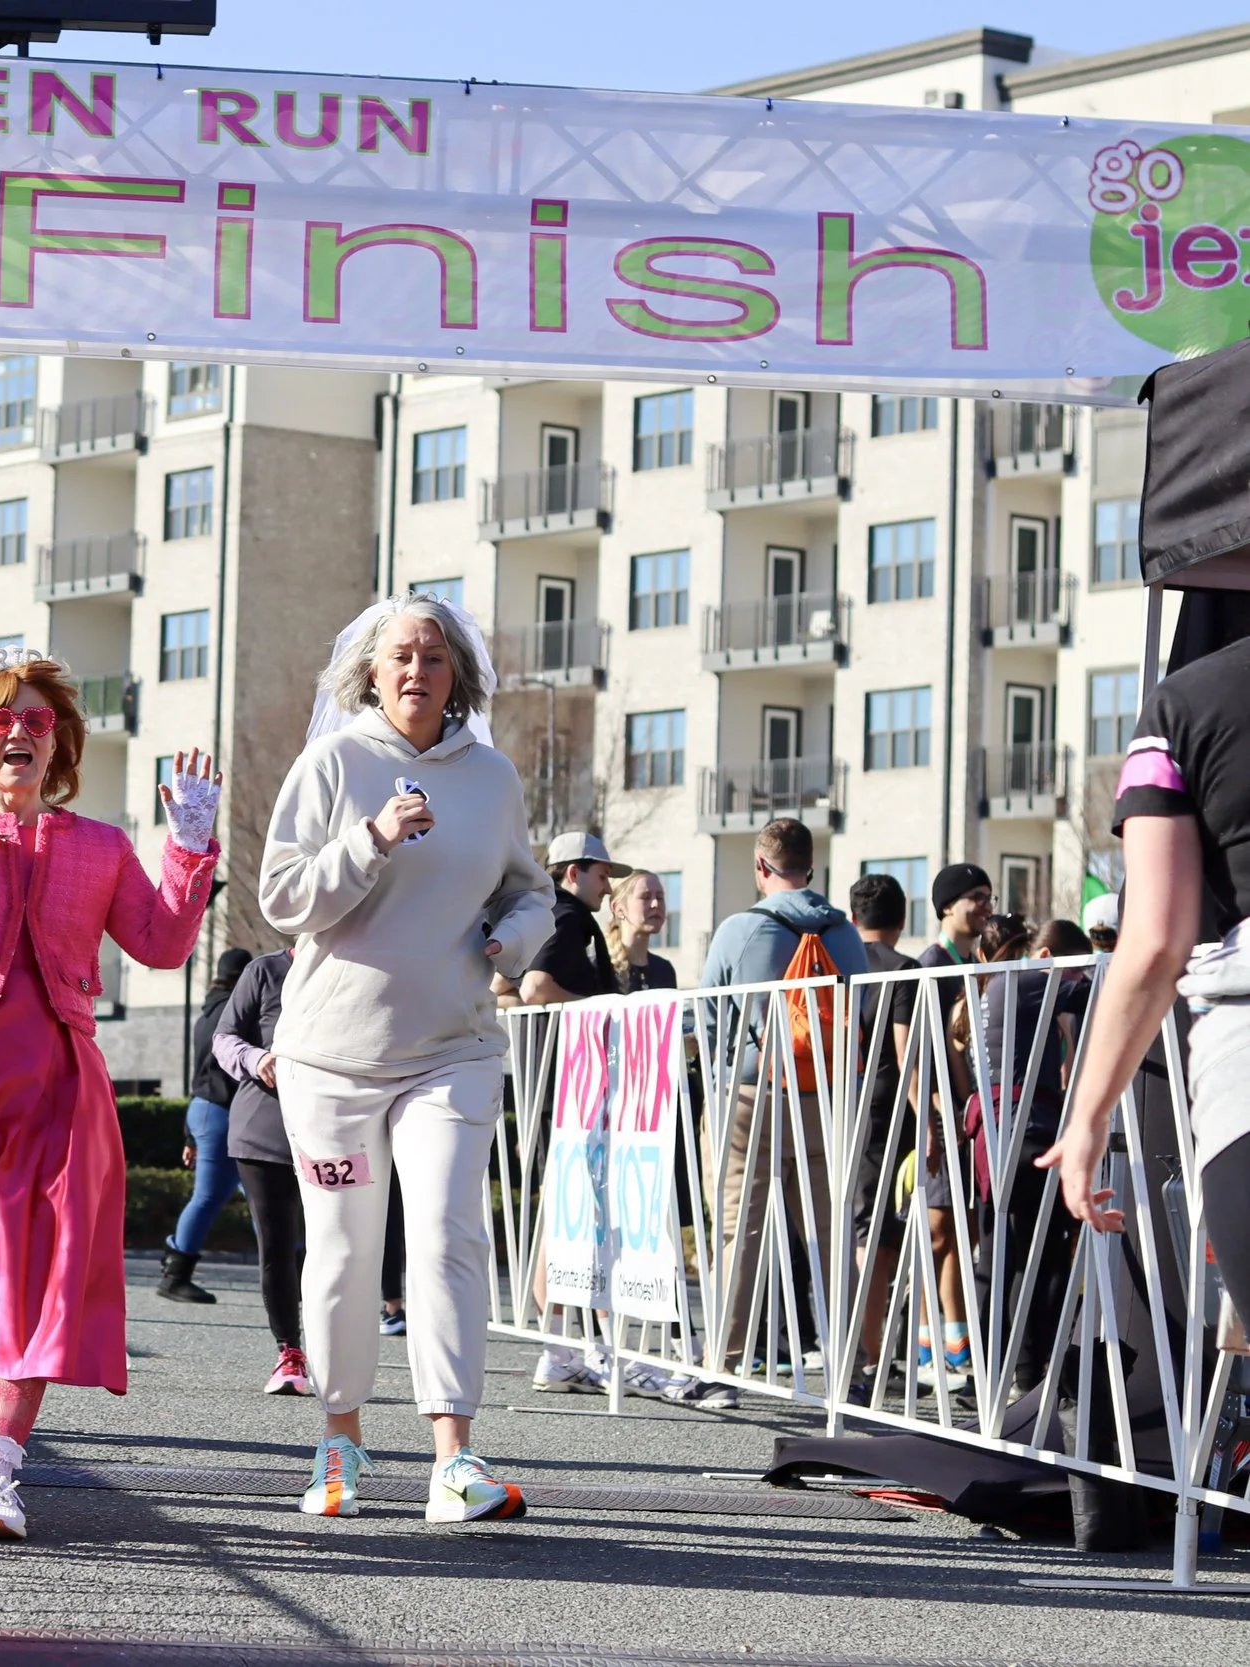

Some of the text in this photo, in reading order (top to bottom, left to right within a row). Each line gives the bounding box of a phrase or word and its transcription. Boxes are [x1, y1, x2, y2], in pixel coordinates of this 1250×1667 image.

[198, 88, 432, 156] RUN
[1088, 140, 1185, 215] go
[1113, 202, 1250, 313] je
[617, 1000, 678, 1133] MIX
[312, 1159, 356, 1186] 132
